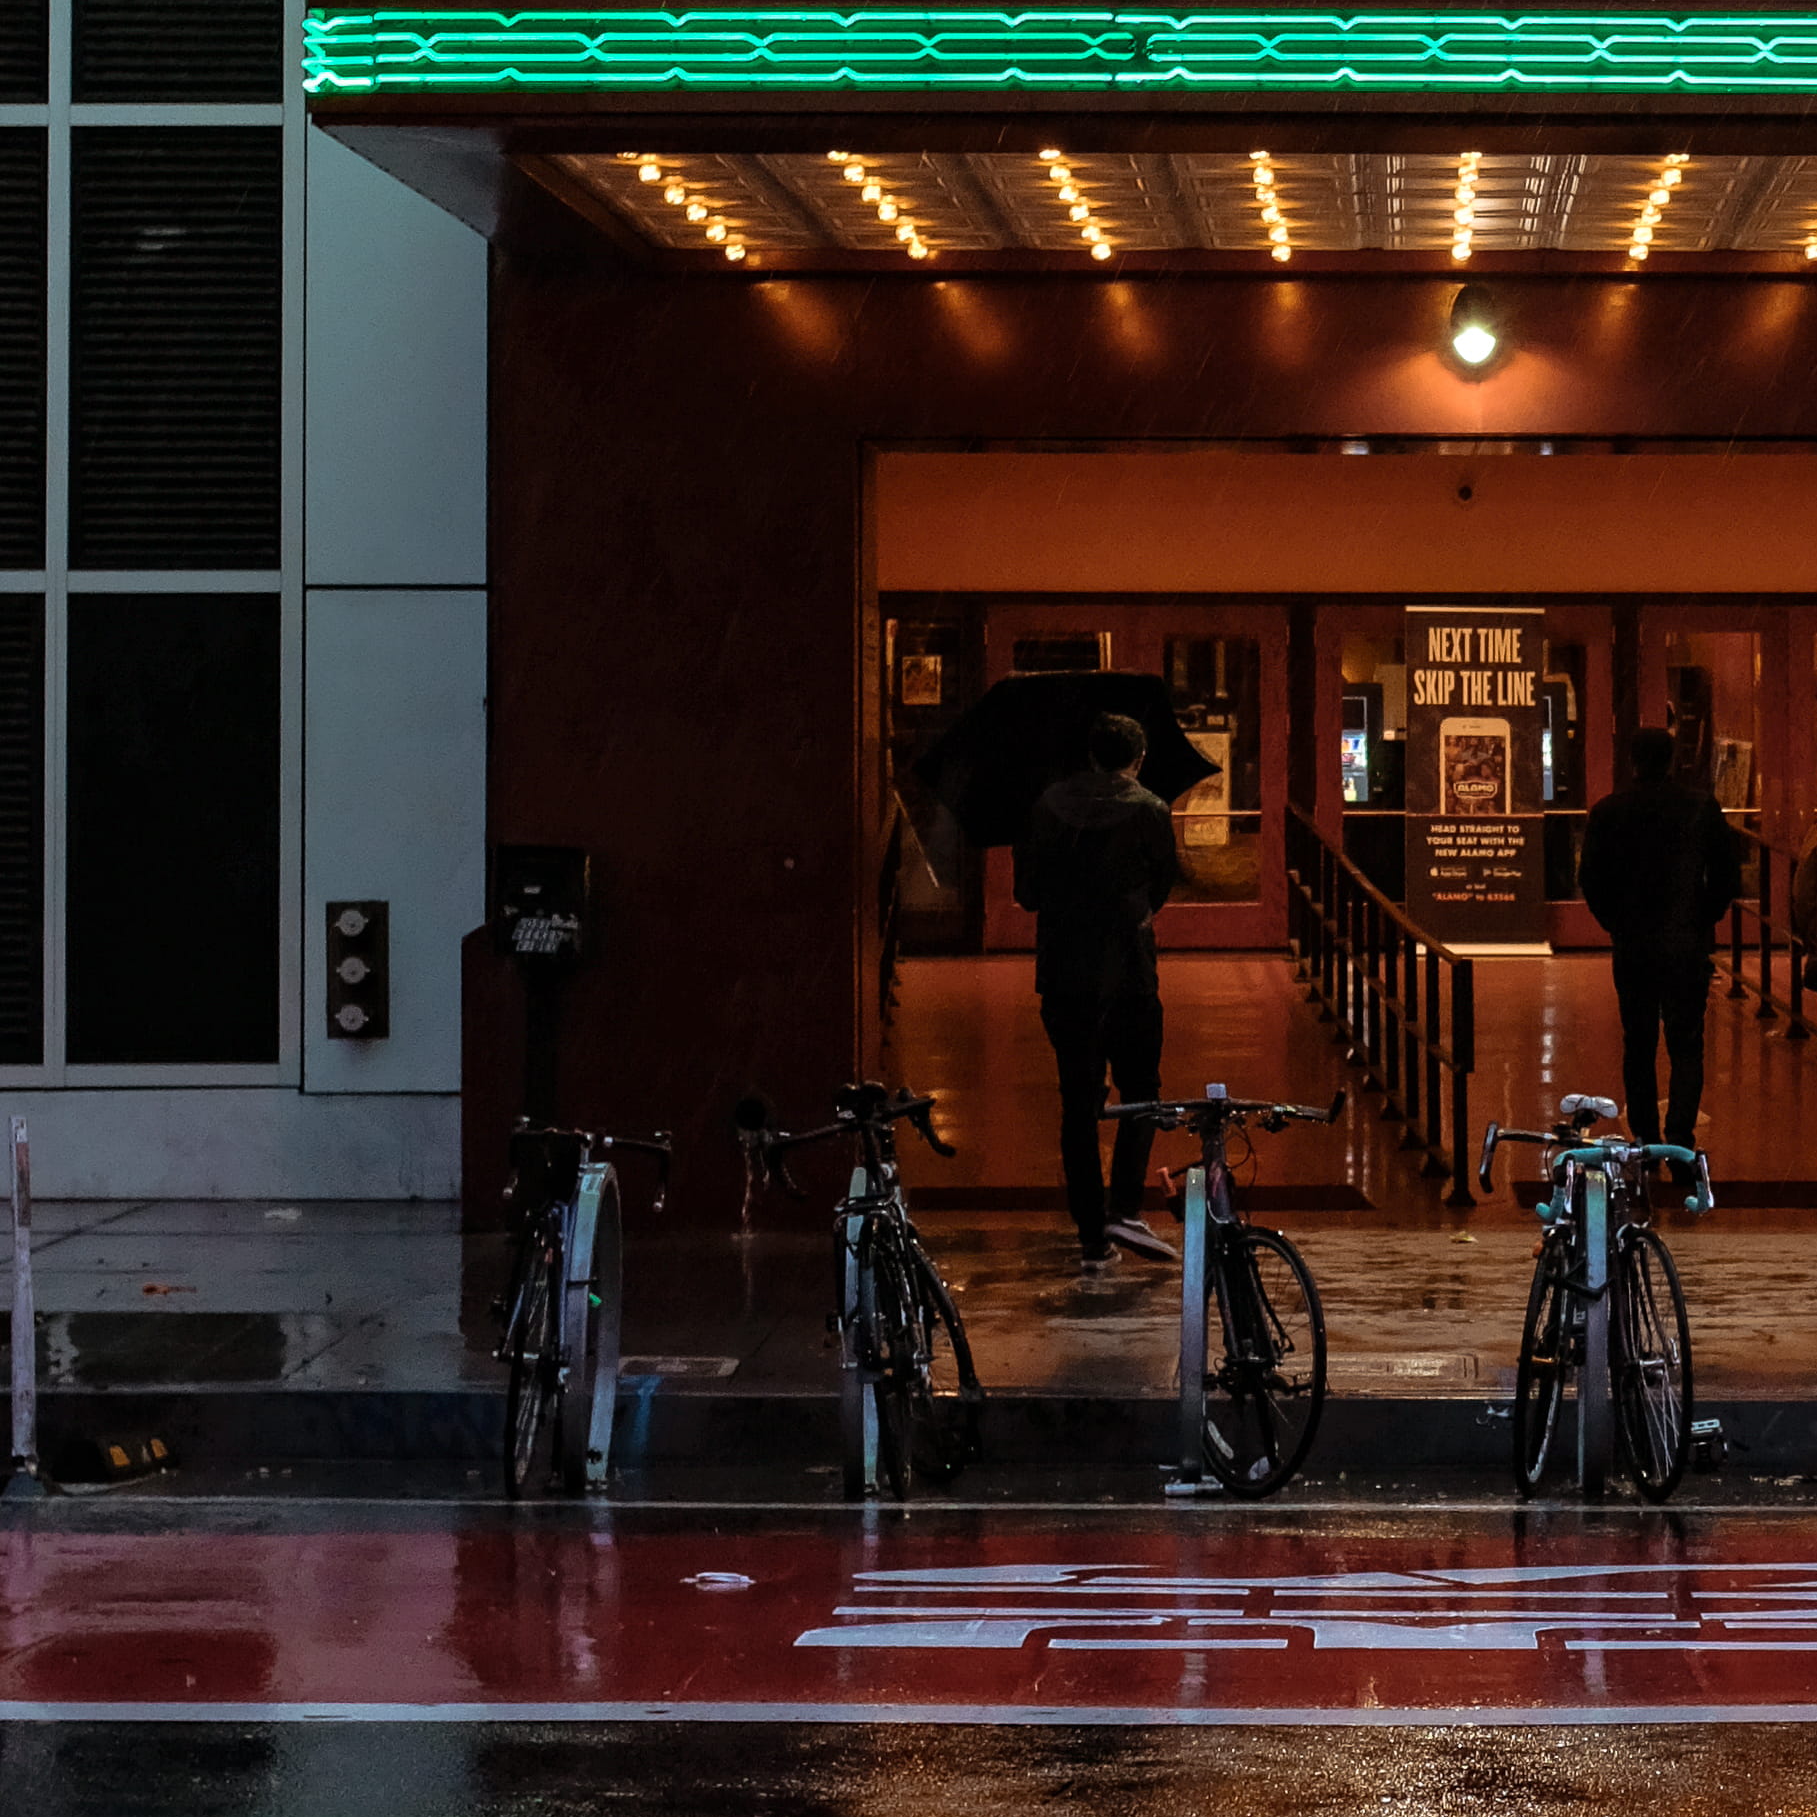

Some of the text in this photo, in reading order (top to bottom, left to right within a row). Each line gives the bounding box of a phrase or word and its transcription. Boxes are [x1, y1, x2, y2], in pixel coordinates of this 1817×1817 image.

[1428, 627, 1522, 663] NEXT TIME
[1413, 669, 1536, 706] SKIP THE LINE
[1457, 784, 1494, 792] ALAMO
[1430, 824, 1520, 834] HEAD STRAIGHT TO
[1426, 836, 1525, 846] YOUR SEAT WITH THE
[1435, 848, 1517, 857] NEW ALAMO APP
